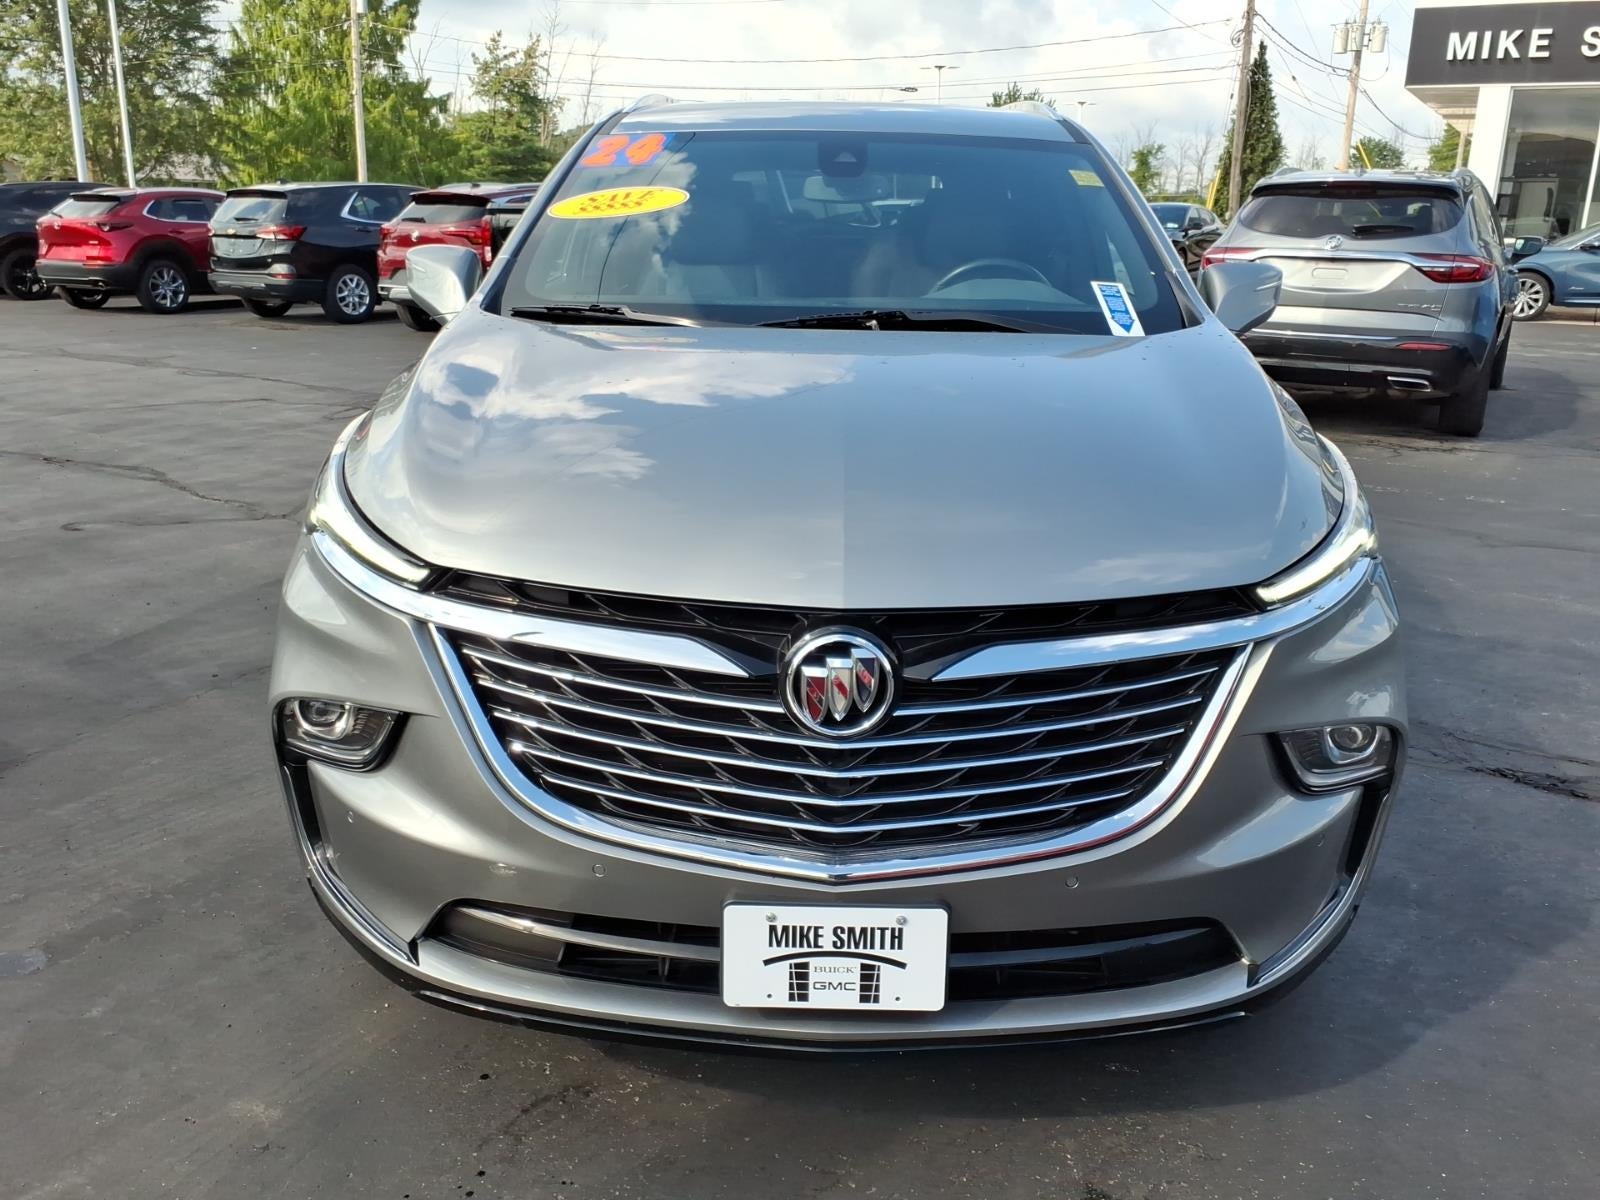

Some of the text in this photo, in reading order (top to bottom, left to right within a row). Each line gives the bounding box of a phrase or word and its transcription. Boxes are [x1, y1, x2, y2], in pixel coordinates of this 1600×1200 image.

[1446, 28, 1553, 60] MIKE
[580, 133, 666, 167] 24
[768, 924, 904, 951] MIKE SMITH
[814, 966, 856, 974] BUICK
[813, 981, 857, 991] GMC
